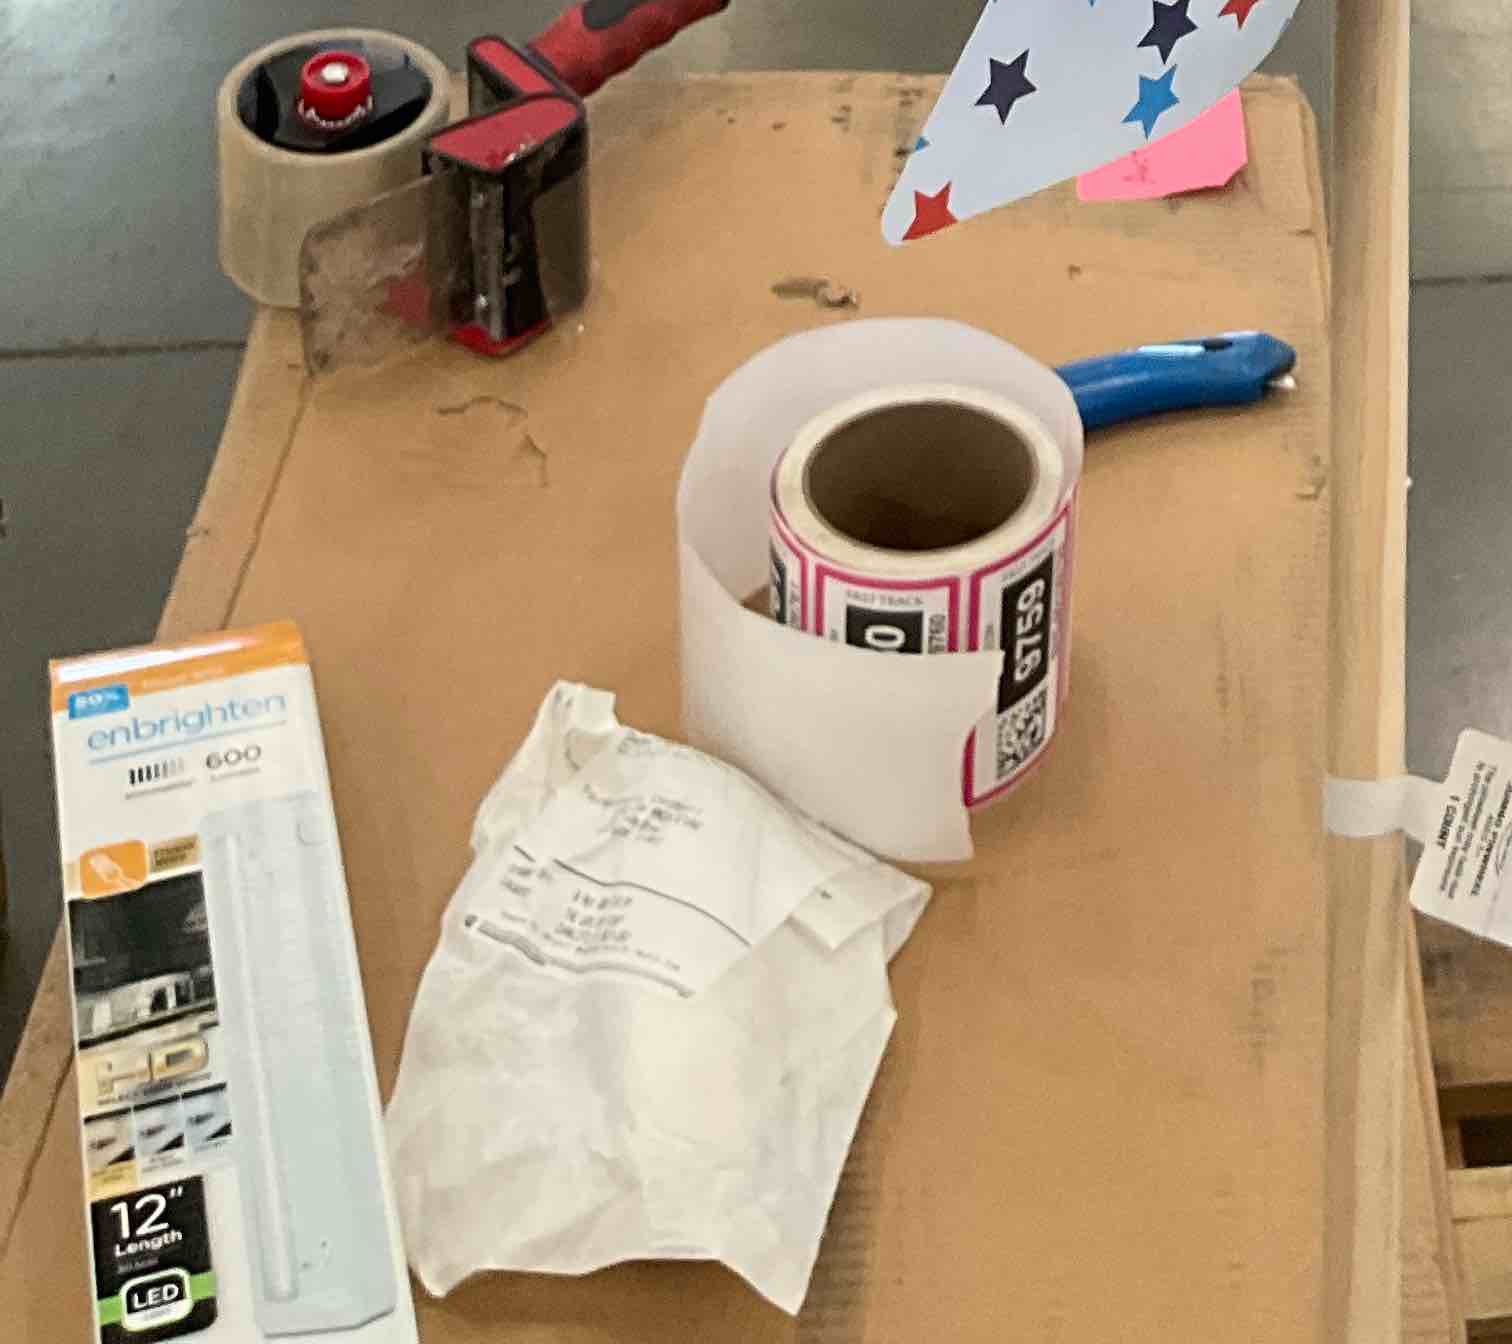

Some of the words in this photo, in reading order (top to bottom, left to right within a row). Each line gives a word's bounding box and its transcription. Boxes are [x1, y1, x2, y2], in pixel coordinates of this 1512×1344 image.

[87, 694, 287, 751] enbrighten
[205, 744, 262, 769] 600
[110, 1185, 183, 1239] 12"
[114, 1229, 183, 1257] Length
[132, 1283, 180, 1309] LED
